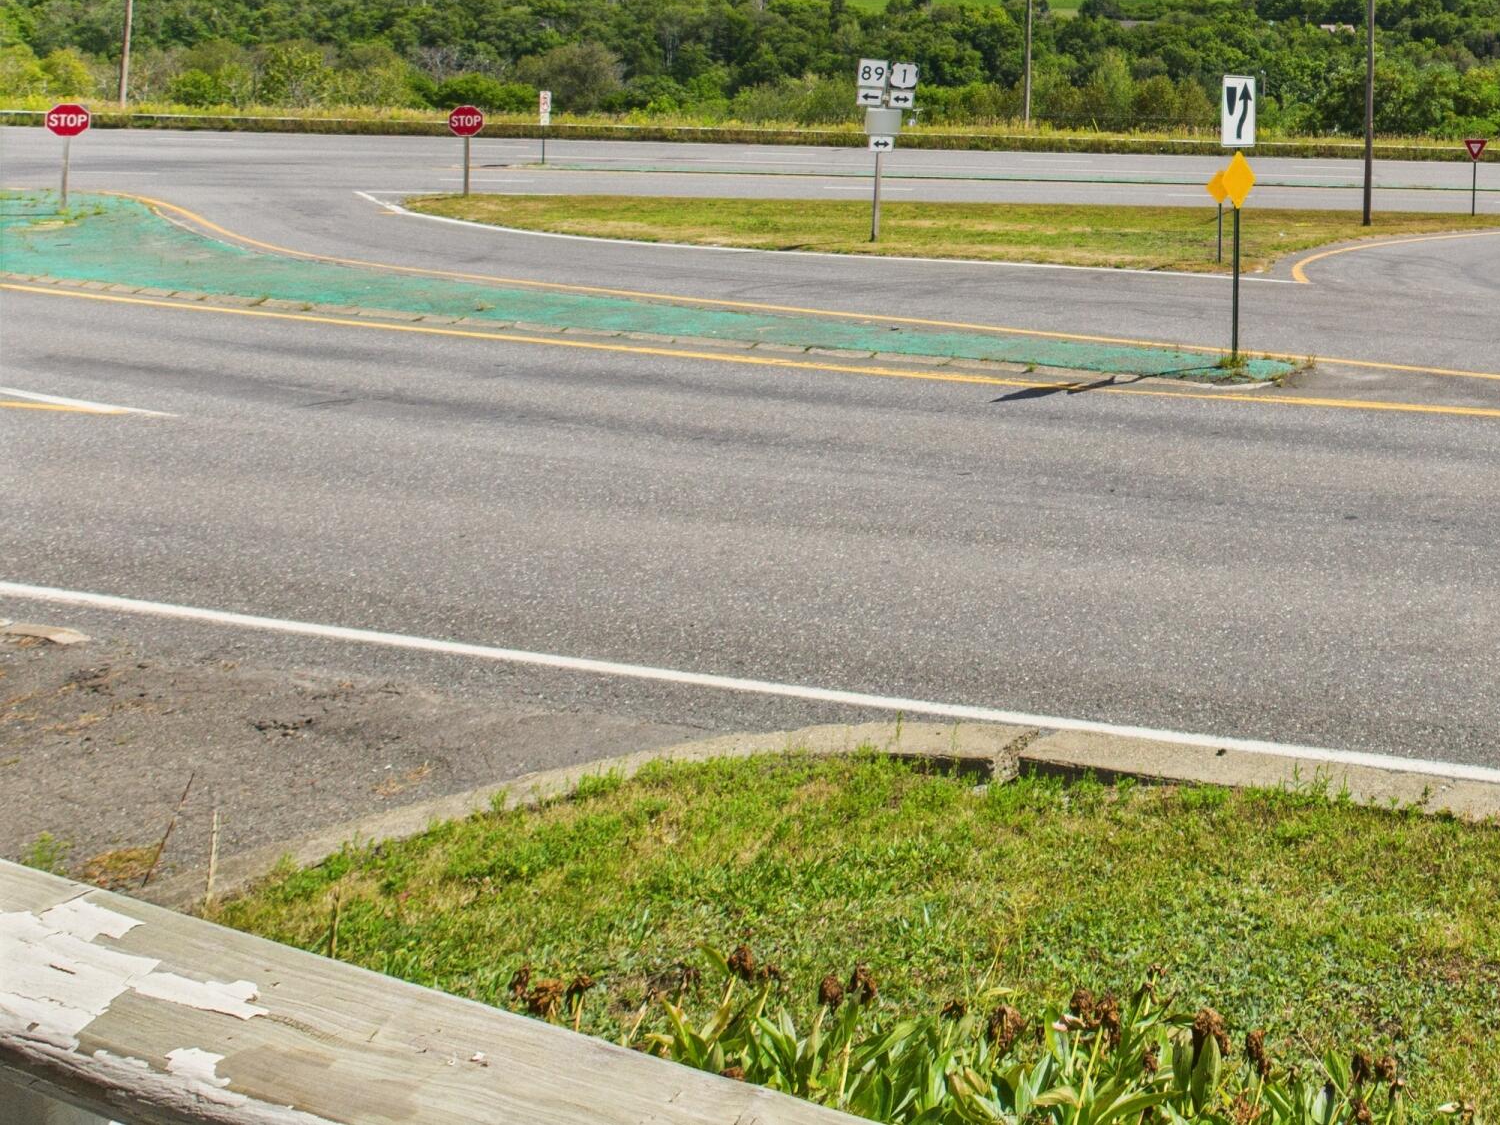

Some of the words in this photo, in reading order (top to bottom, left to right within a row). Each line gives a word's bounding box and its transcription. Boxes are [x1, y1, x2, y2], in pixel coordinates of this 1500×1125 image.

[861, 65, 885, 81] 89
[901, 69, 907, 83] 1
[49, 114, 88, 127] STOP
[451, 115, 482, 127] STOP
